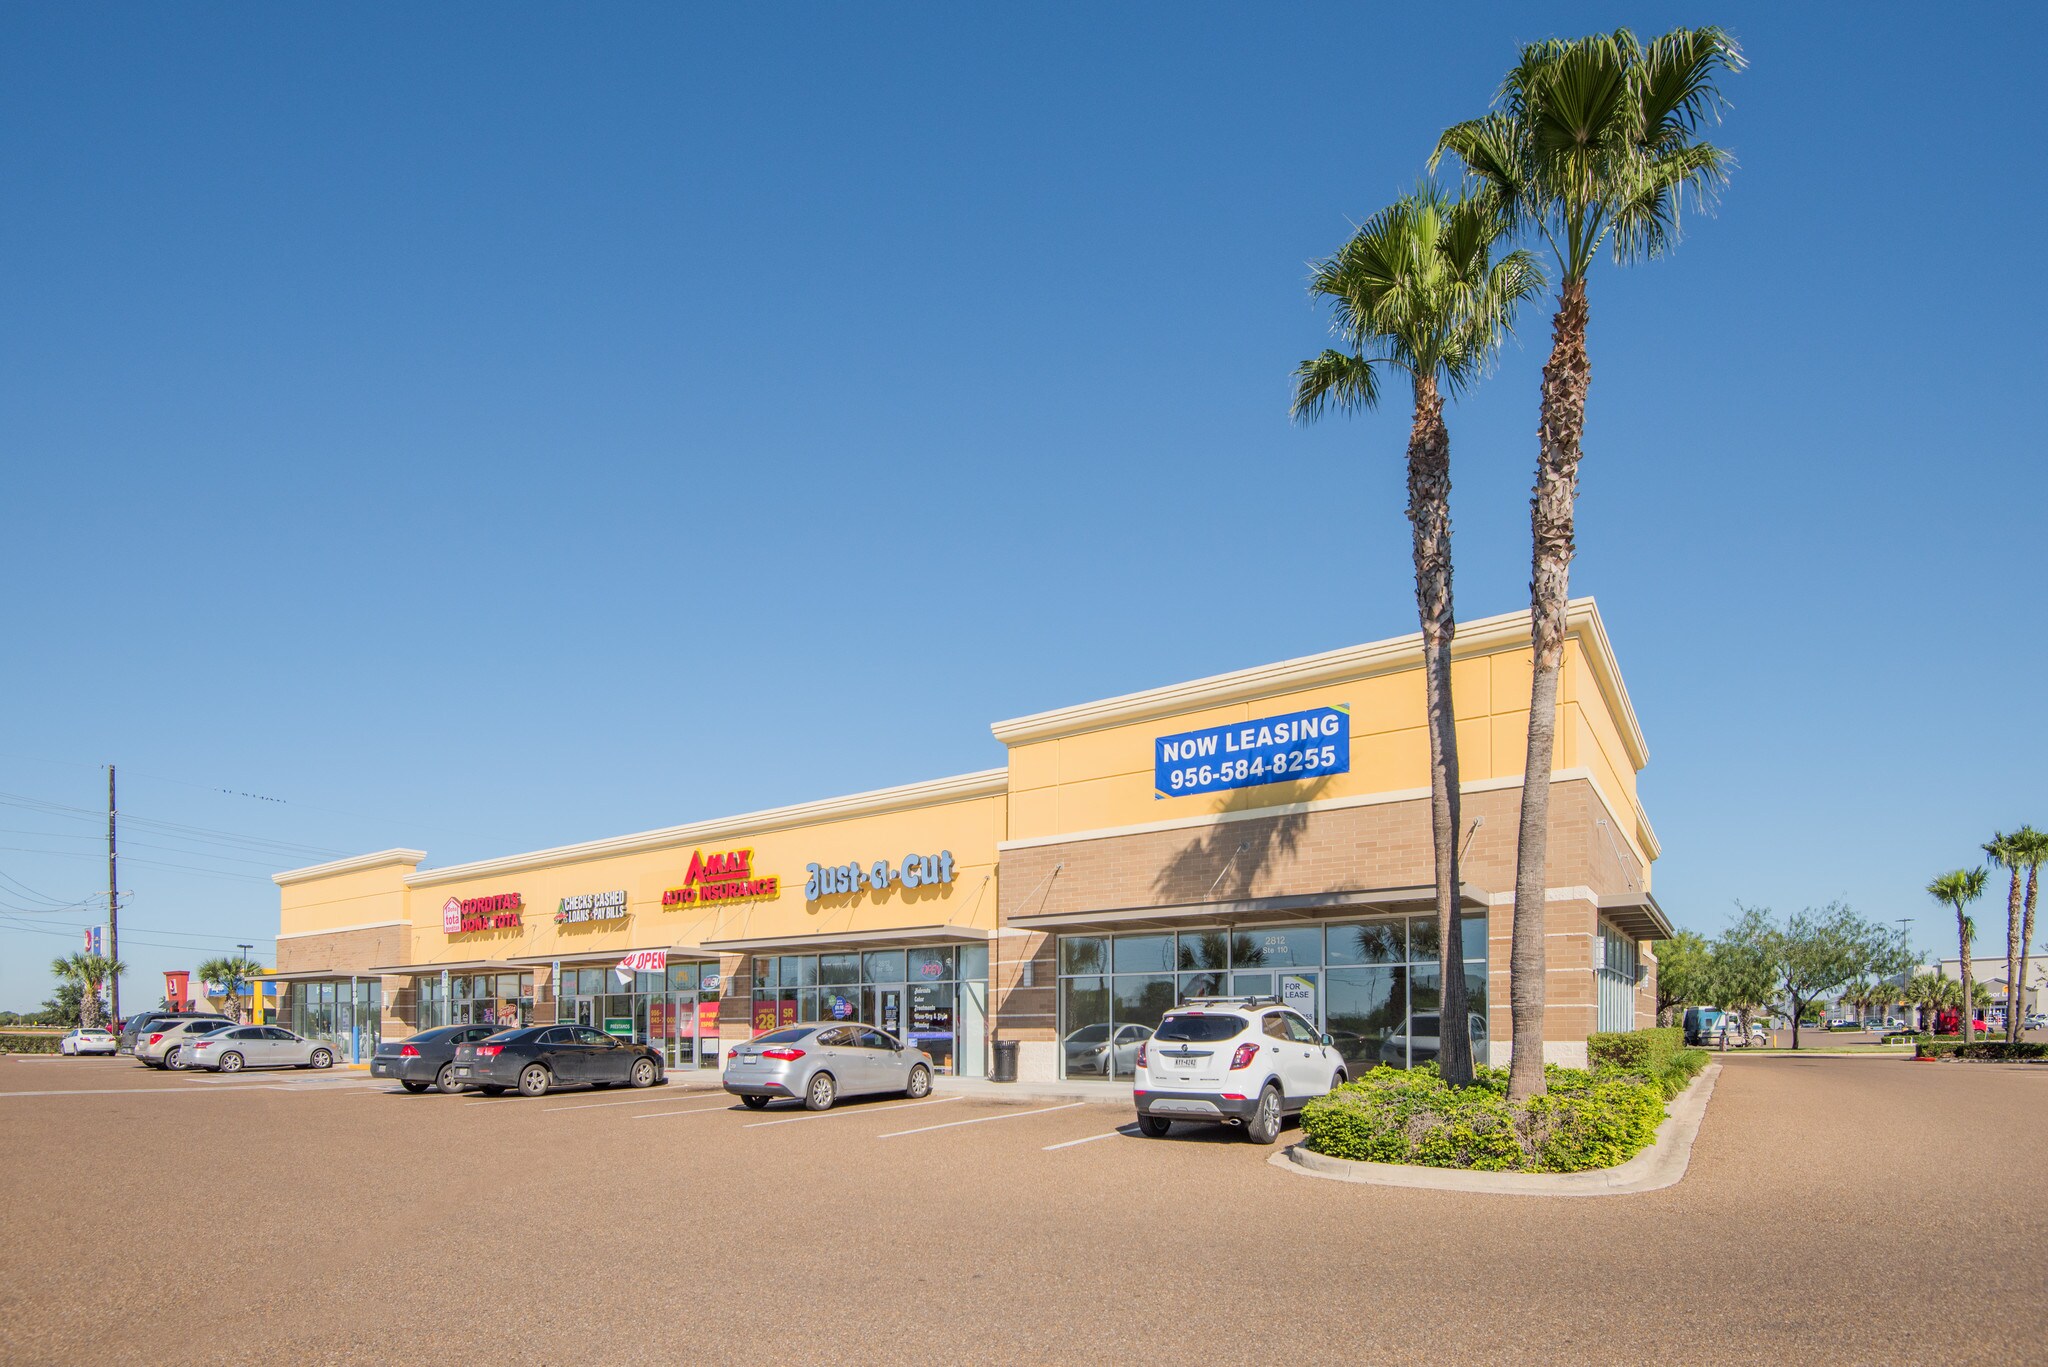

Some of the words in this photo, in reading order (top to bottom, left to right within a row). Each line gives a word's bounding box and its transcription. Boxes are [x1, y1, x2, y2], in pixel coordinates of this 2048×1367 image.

[1163, 734, 1218, 763] NOW
[1225, 714, 1339, 753] LEASING
[1170, 745, 1336, 790] 956-584-8255
[661, 888, 695, 905] AUTO
[700, 878, 777, 902] INSURANCE
[461, 892, 520, 915] GORDITAS
[564, 894, 593, 911] CHECKS
[594, 890, 625, 908] CASHED
[446, 914, 459, 925] tota
[492, 913, 519, 929] TOTA
[568, 909, 590, 923] LOANS
[593, 907, 606, 920] PAY
[605, 905, 625, 919] BILLS
[1265, 936, 1286, 945] 2812
[1262, 946, 1275, 954] Ste
[635, 951, 665, 970] OPEN
[921, 963, 941, 975] OPEN
[1285, 991, 1309, 999] LEASE
[783, 1007, 794, 1018] SR
[755, 1013, 776, 1029] $28
